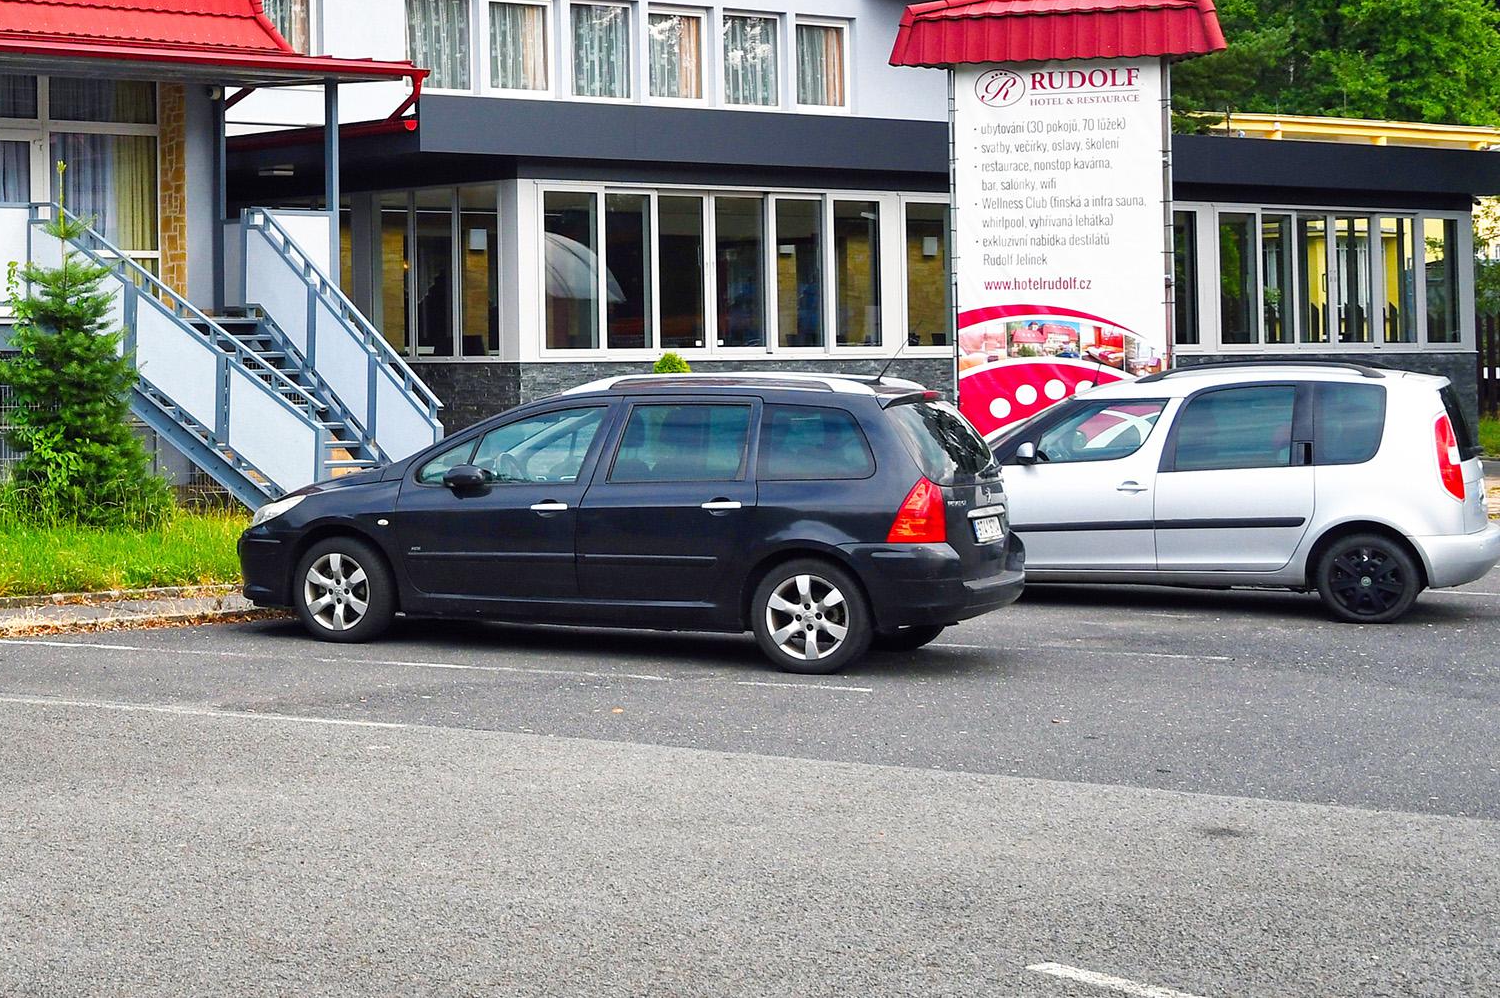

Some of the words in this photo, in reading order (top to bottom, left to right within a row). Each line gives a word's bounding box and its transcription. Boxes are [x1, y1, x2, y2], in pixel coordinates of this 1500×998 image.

[1030, 67, 1139, 90] RUDOLF
[1030, 97, 1062, 106] HOTEL
[1066, 97, 1074, 105] &
[1077, 94, 1139, 104] RESTAURACE
[981, 121, 1024, 135] ubytování
[1027, 121, 1043, 133] (30
[1047, 118, 1080, 134] pokojů,
[1083, 118, 1094, 131] 70
[1097, 118, 1126, 130] lůžek)
[981, 141, 1012, 154] svatby,
[1015, 140, 1050, 153] večírky,
[1052, 139, 1083, 152] oslavy,
[1086, 137, 1120, 150] školení
[981, 160, 1031, 172] restaurace,
[1034, 158, 1071, 172] nonstop
[1074, 156, 1113, 170] kavárna,
[982, 179, 998, 191] bar,
[1040, 178, 1056, 189] wifi
[982, 197, 1023, 209] Wellness
[1026, 196, 1047, 208] Club
[1050, 196, 1081, 208] (finská
[1084, 199, 1089, 207] a
[1092, 196, 1113, 207] infra
[1116, 196, 1147, 207] sauna,
[982, 216, 1027, 230] whirlpool,
[1029, 214, 1072, 229] vyhřívaná
[1075, 214, 1114, 226] lehátka)
[1030, 233, 1066, 246] nabídka
[1069, 233, 1110, 246] destilátů
[983, 254, 1013, 266] Rudolf
[1016, 253, 1048, 265] Jelínek
[984, 277, 1091, 290] www.hotelrudolf.cz
